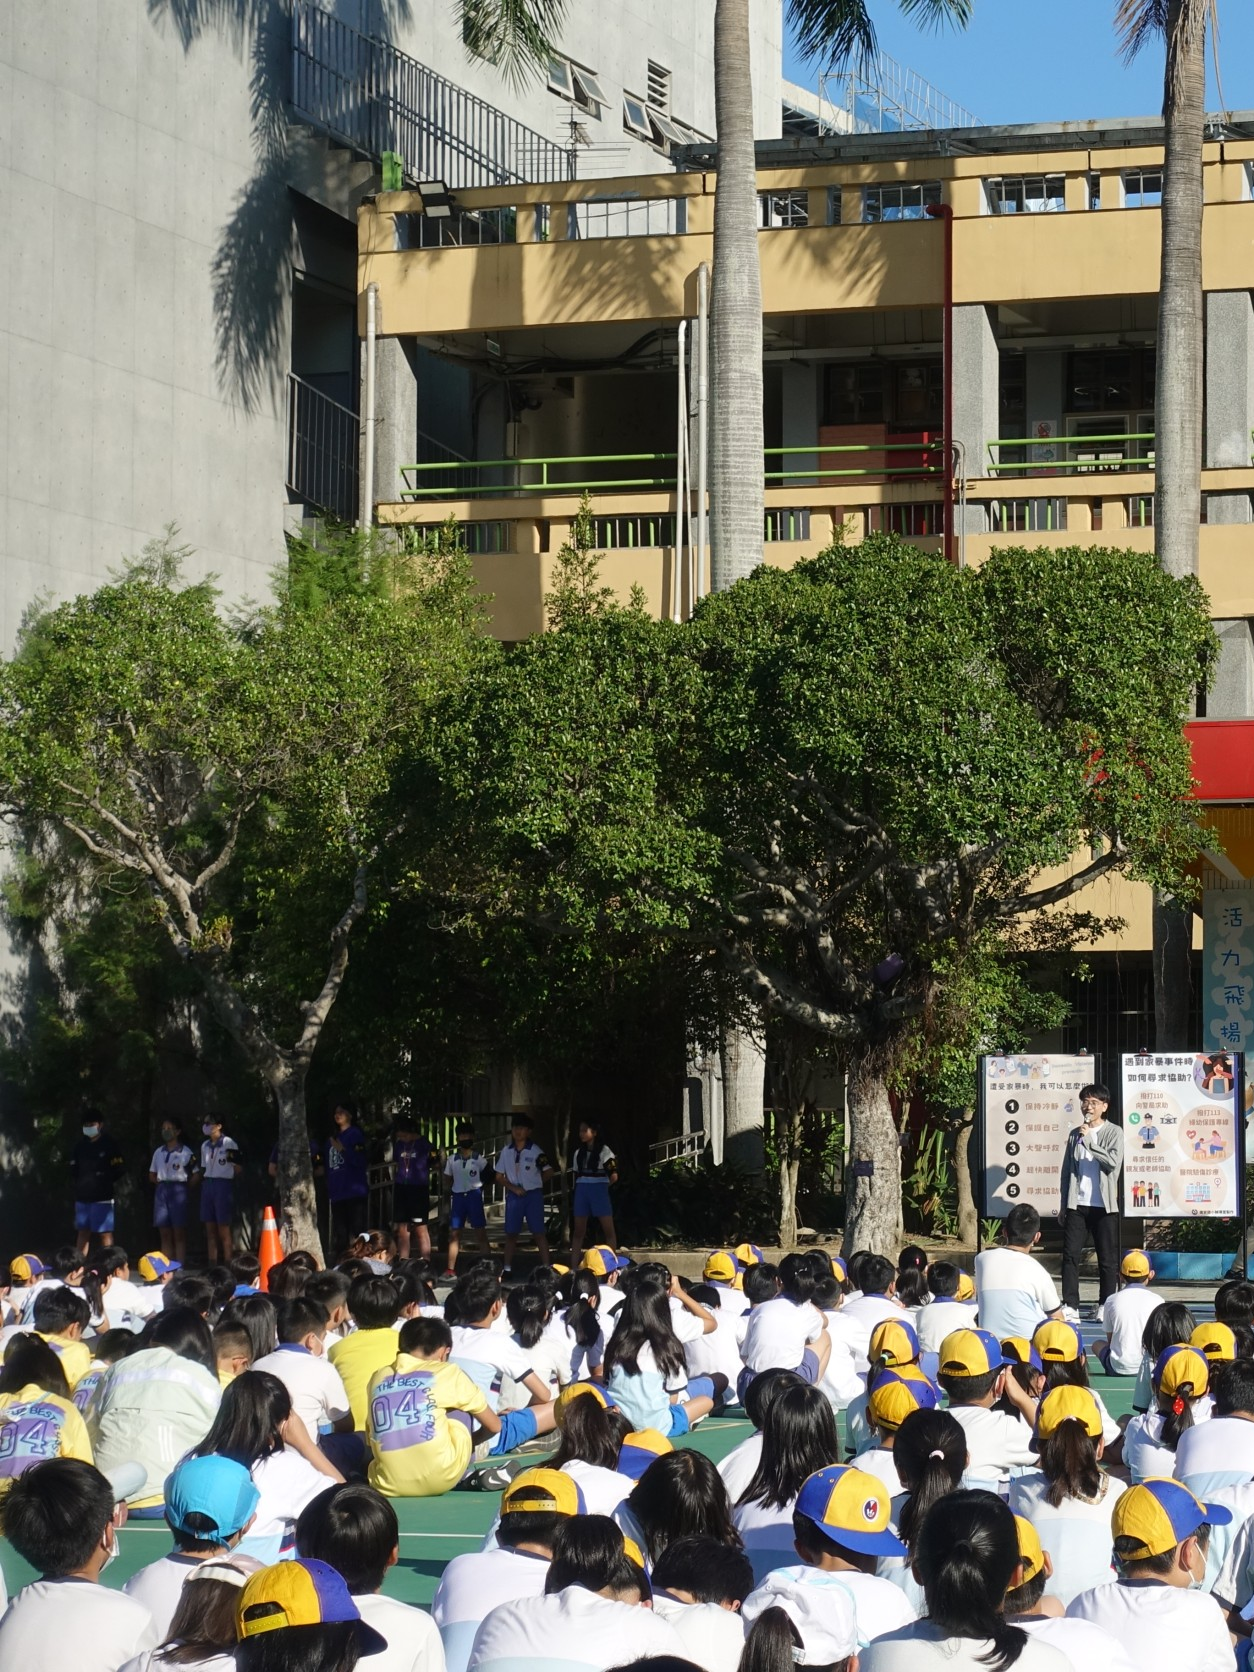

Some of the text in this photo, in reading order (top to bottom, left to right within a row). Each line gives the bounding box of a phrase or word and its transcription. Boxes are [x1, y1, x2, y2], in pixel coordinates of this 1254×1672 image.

[1220, 907, 1245, 1043] 活力飛揚
[1124, 1057, 1193, 1066] 遇到家暴事件時
[397, 1377, 425, 1389] BEST
[29, 1406, 57, 1421] BEST
[370, 1389, 420, 1434] 04
[0, 1419, 48, 1459] 04
